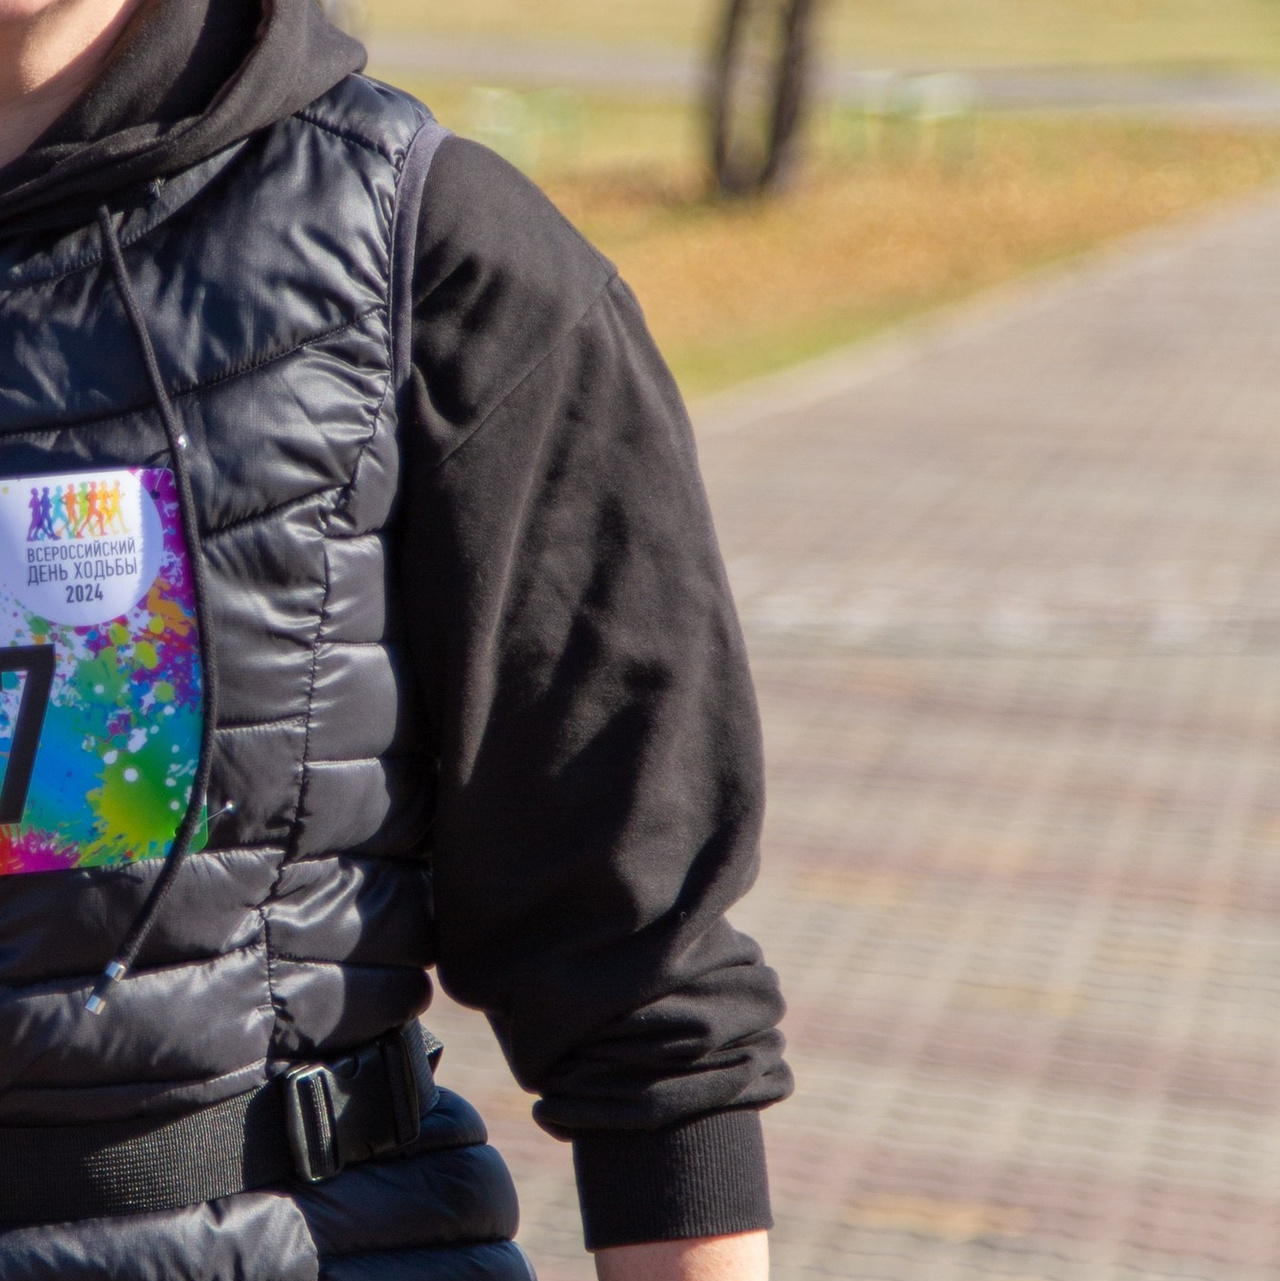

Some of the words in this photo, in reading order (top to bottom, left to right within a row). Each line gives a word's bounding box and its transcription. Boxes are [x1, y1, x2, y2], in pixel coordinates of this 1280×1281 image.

[27, 537, 136, 563] ВСЕРОССИЙСКИЙ
[28, 564, 68, 586] ДЕНЬ
[74, 557, 138, 581] ХОДЬБЫ
[65, 583, 104, 603] 2024
